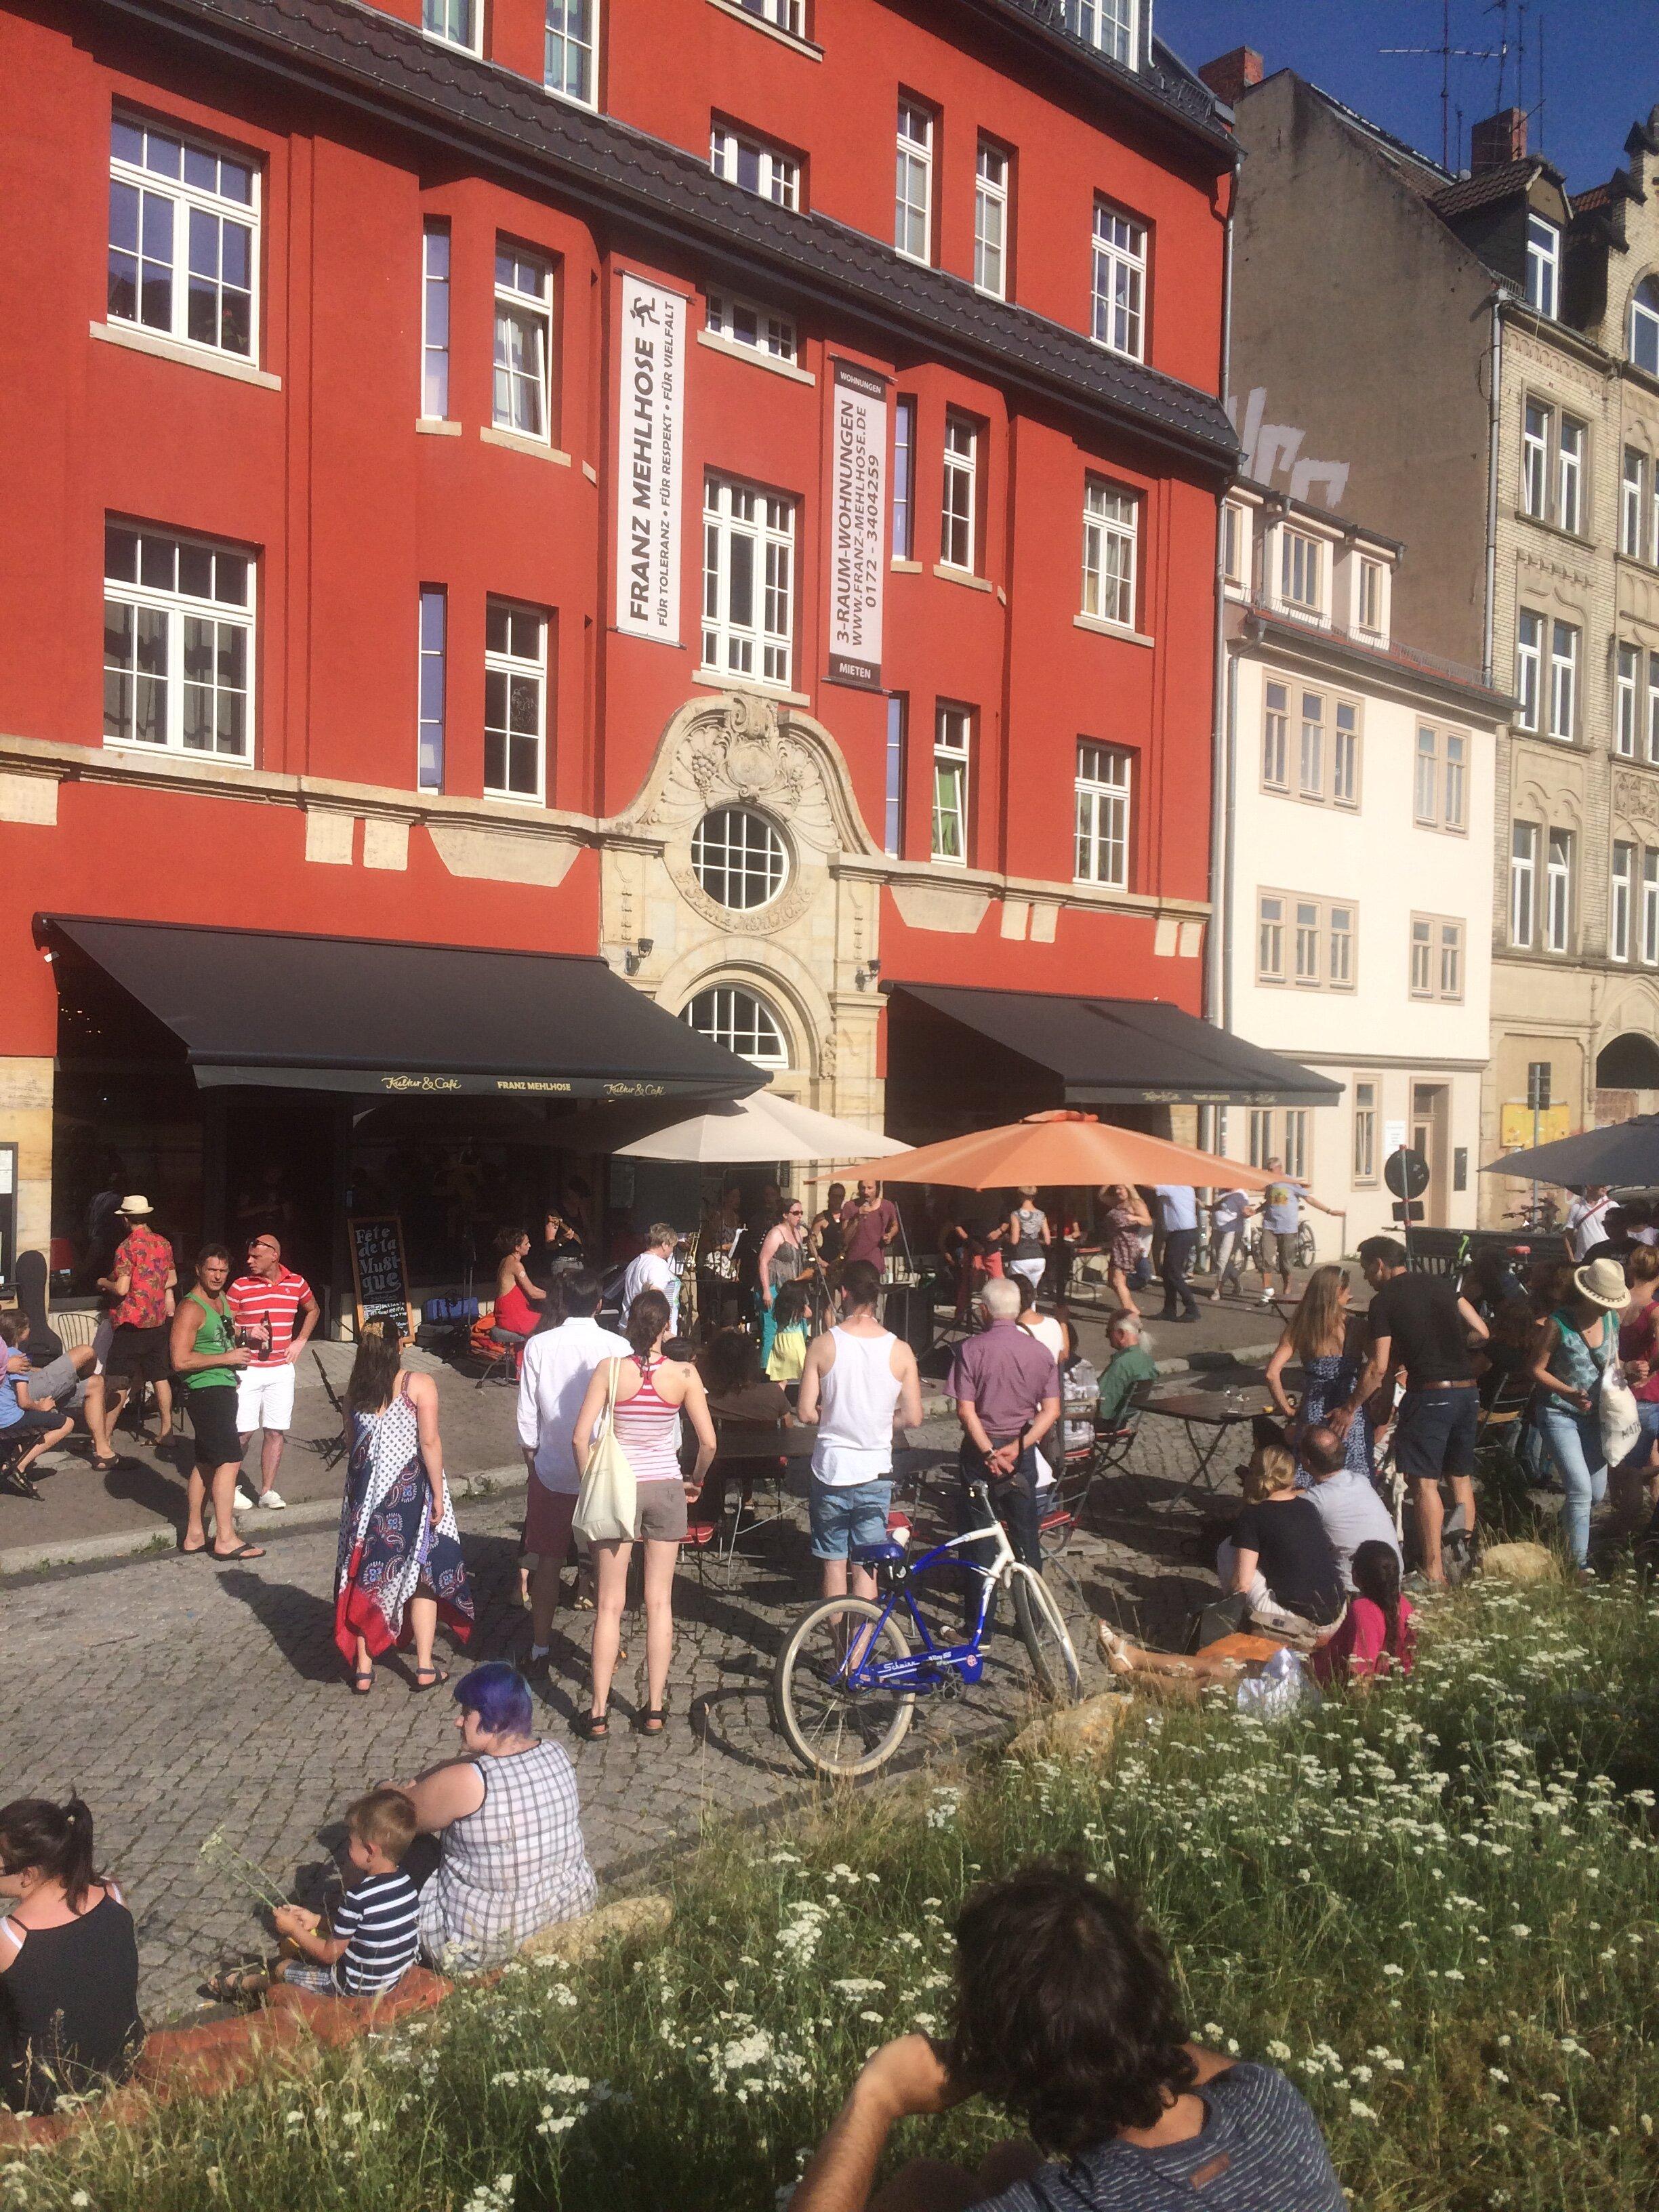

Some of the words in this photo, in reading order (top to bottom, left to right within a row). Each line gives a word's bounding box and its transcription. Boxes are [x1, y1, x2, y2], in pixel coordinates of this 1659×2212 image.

[664, 301, 674, 369] VIELFALT
[661, 372, 673, 401] FÜR
[840, 371, 882, 394] WOHNUNGEN
[632, 337, 654, 510] MEHLHOSE
[661, 413, 672, 475] RESPEKT
[659, 477, 671, 507] FÜR
[867, 454, 879, 542] 3404259
[837, 400, 854, 644] 3-RAUM-WOHNUNGEN
[852, 405, 867, 646] WWW.FRANZ-MEHLHOSE.DE
[630, 515, 651, 621] FRANZ
[659, 519, 670, 594] TOLERANZ
[865, 559, 877, 608] 0172
[657, 597, 668, 627] FÜR
[840, 662, 871, 679] MIETEN
[382, 1076, 422, 1090] Kultur
[422, 1076, 436, 1090] &
[435, 1077, 462, 1091] Café
[497, 1081, 526, 1090] FRANZ
[527, 1082, 571, 1091] MEHLHOSE
[634, 1084, 645, 1097] &
[645, 1084, 666, 1097] Café
[359, 1241, 378, 1257] de
[363, 1272, 399, 1294] que
